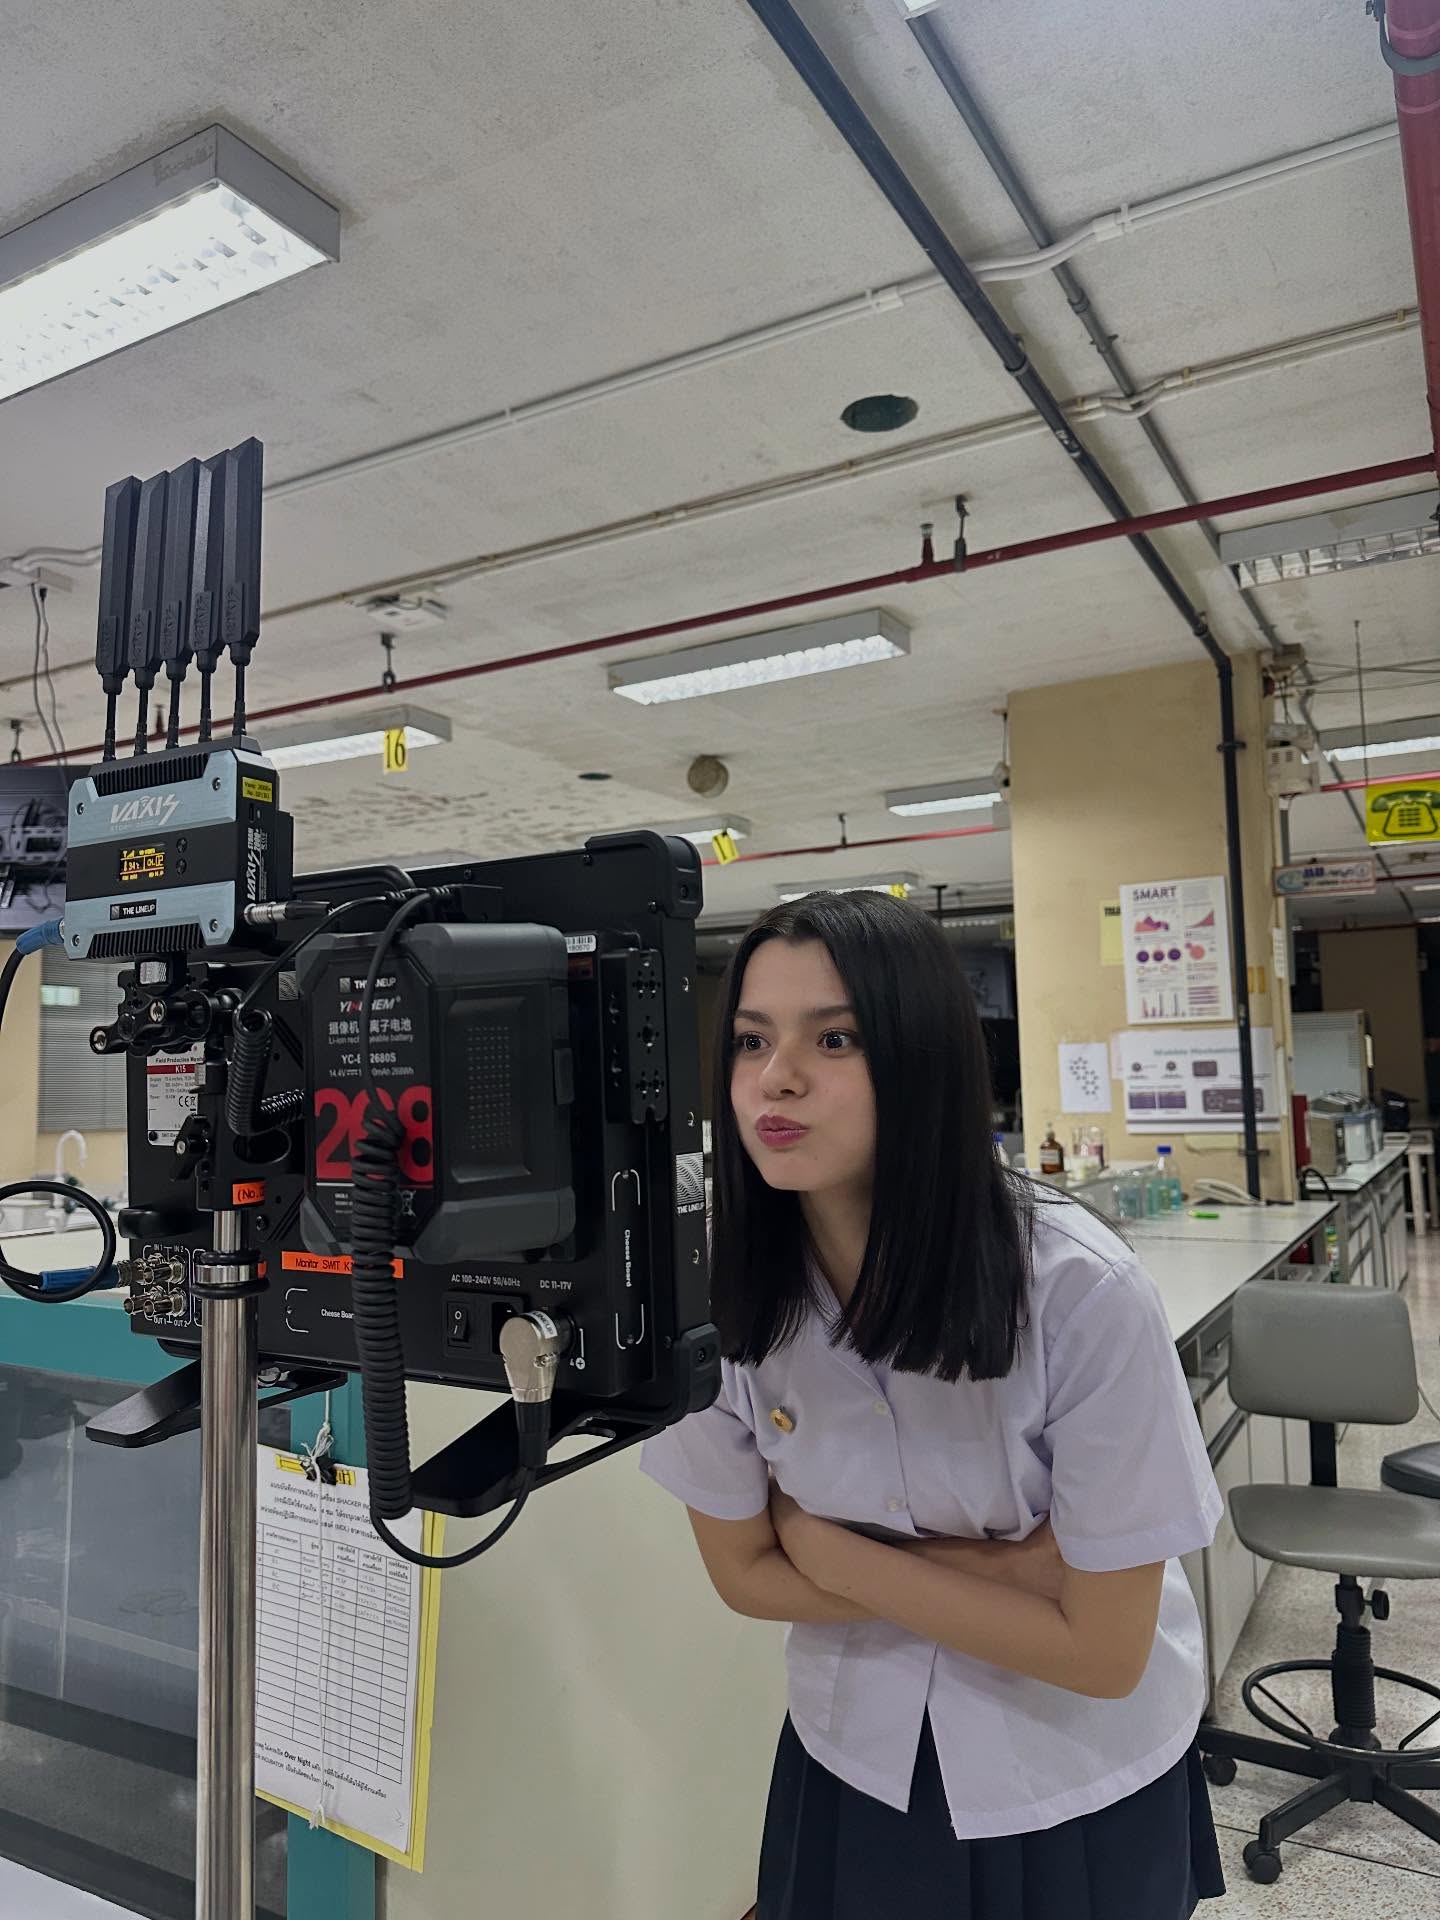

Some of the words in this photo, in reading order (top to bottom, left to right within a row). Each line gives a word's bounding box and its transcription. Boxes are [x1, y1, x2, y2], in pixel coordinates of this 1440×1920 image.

[385, 732, 406, 769] 16
[110, 793, 181, 826] VAXIS
[1132, 886, 1177, 901] SMART
[122, 906, 135, 916] THE
[135, 903, 156, 914] LINEUP
[328, 1017, 412, 1035] 摄像机离子电池
[175, 1065, 187, 1073] K15
[295, 1257, 318, 1269] Monitor
[322, 1259, 340, 1271] SWIT
[451, 1274, 461, 1283] AC
[461, 1274, 492, 1285] 100-240V
[493, 1276, 521, 1287] 50/60Hz
[539, 1279, 551, 1289] DC
[551, 1280, 572, 1290] 11-17V
[321, 1308, 340, 1318] Cheese
[284, 1751, 297, 1762] Over
[297, 1755, 312, 1769] Night
